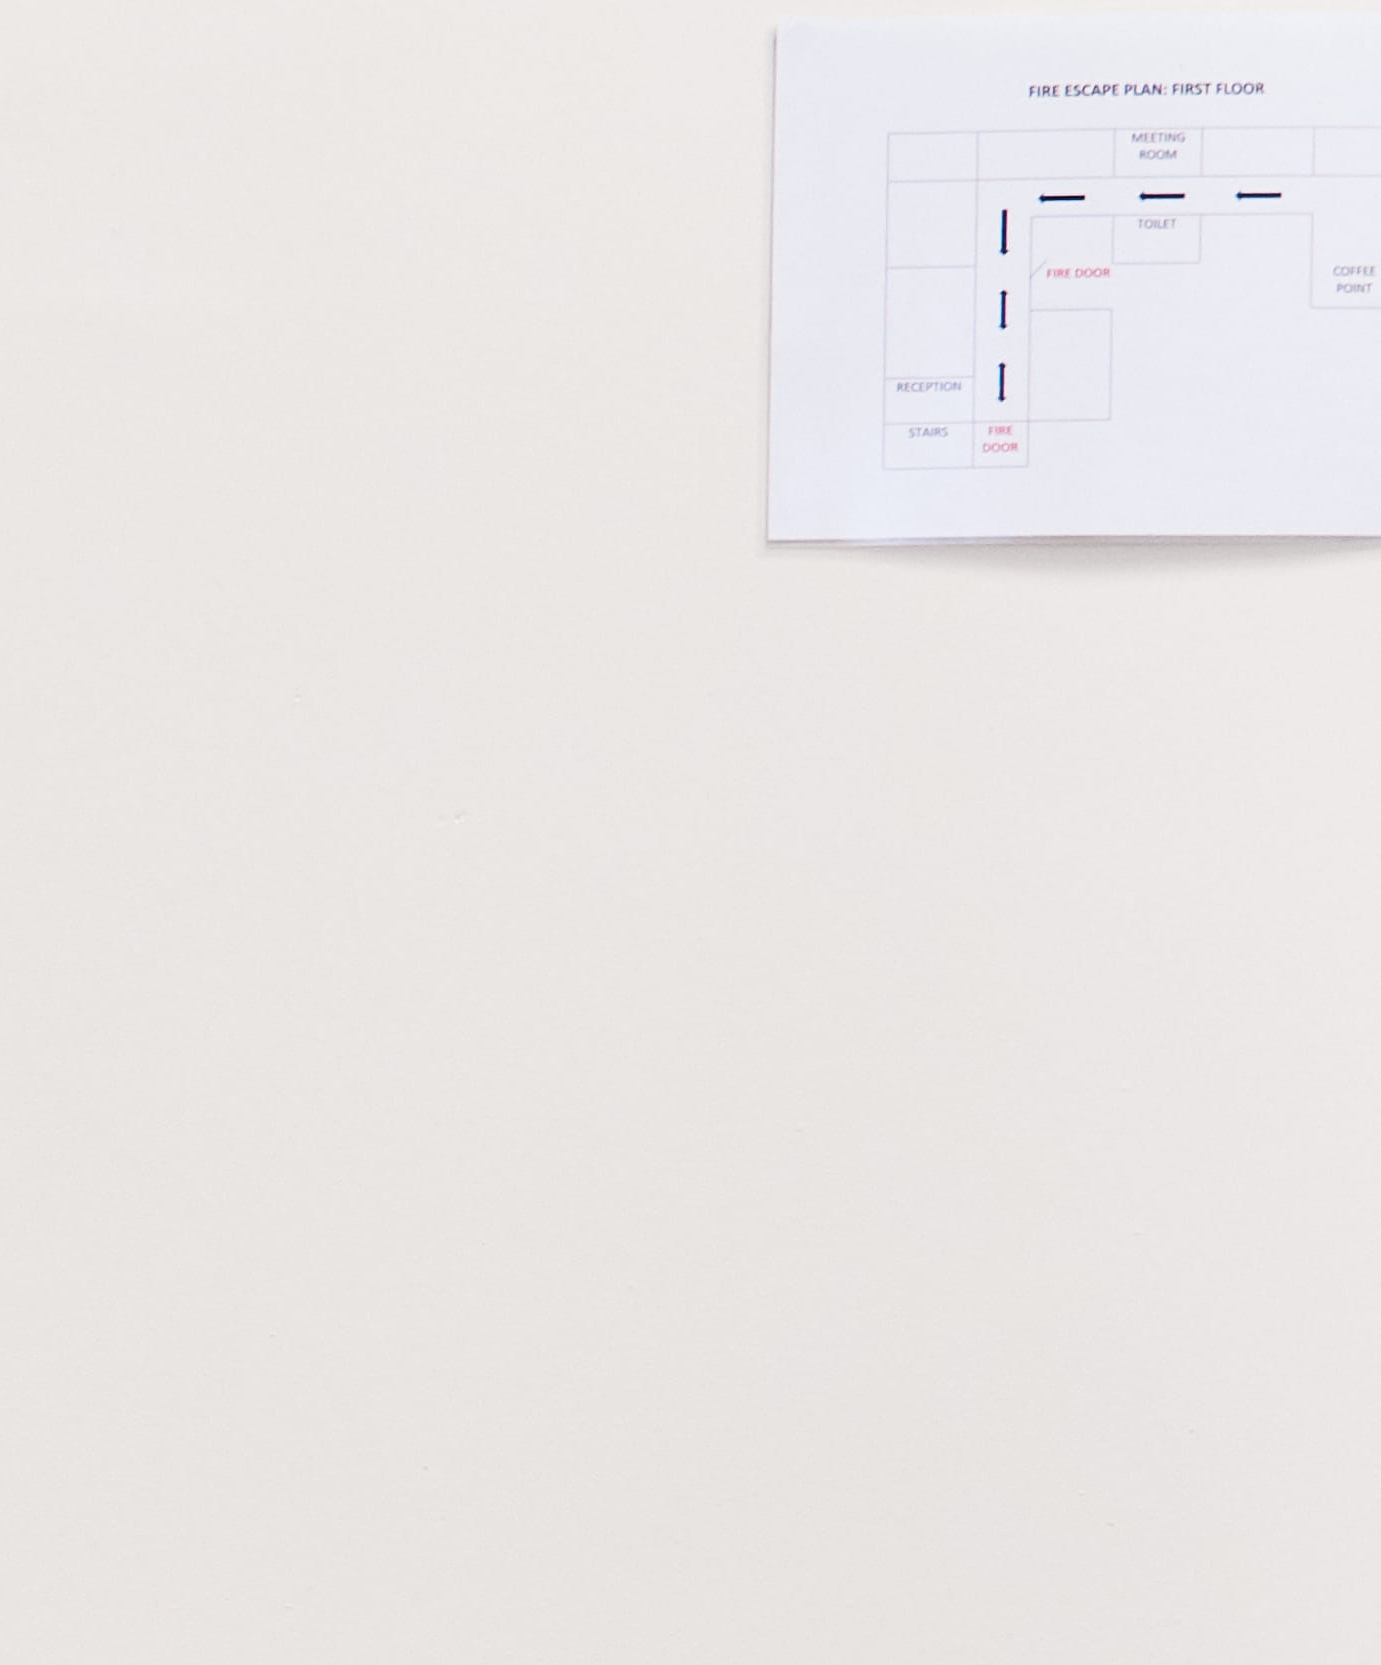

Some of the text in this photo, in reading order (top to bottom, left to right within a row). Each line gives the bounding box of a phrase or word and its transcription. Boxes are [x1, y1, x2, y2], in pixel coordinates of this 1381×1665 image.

[1028, 82, 1265, 98] FIRE ESCAPE PLAN: FIRST FLOOR
[1131, 132, 1186, 144] MEETING
[1139, 149, 1178, 160] ROOM
[1138, 218, 1176, 230] TOILET
[1046, 268, 1111, 279] FIRE DOOR
[1333, 265, 1377, 277] COFFEE
[1336, 283, 1372, 294] POINT
[896, 381, 962, 393] RECEPTION
[908, 426, 949, 438] STAIRS
[988, 425, 1013, 436] FIRE
[982, 442, 1019, 453] DOOR
